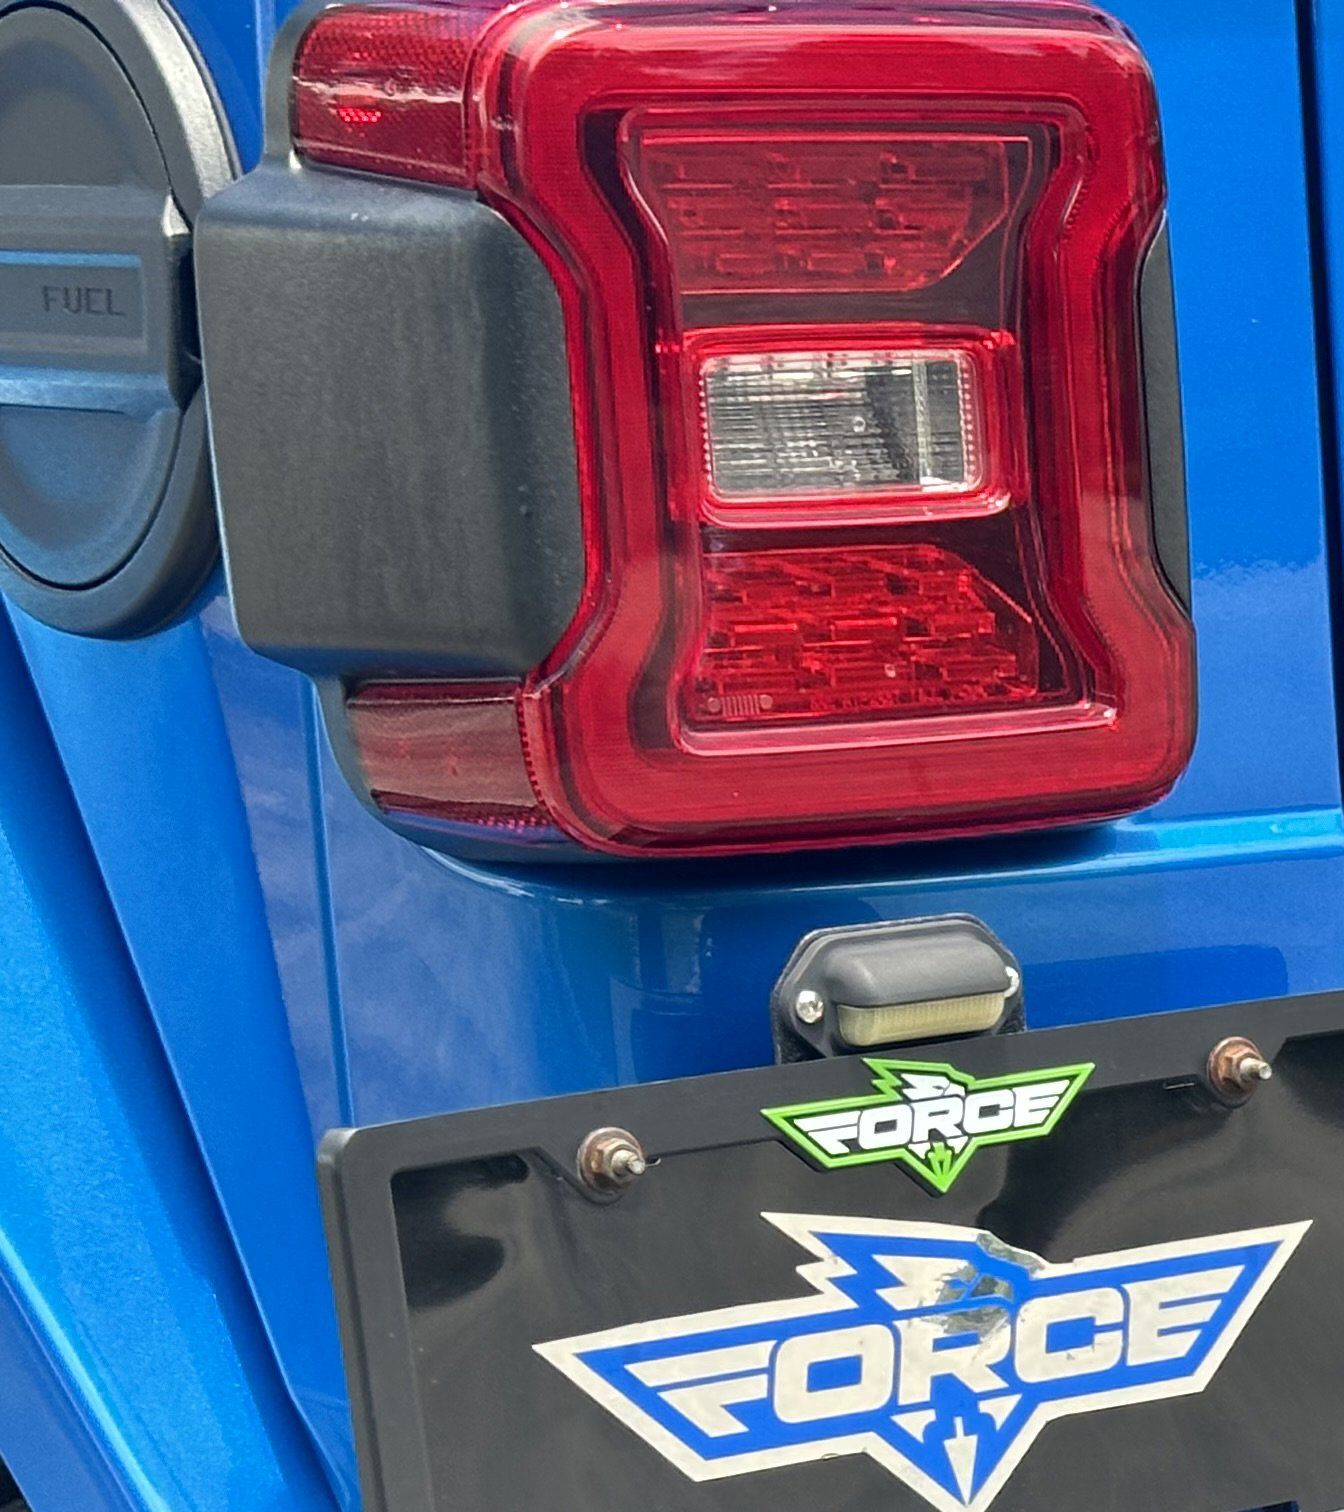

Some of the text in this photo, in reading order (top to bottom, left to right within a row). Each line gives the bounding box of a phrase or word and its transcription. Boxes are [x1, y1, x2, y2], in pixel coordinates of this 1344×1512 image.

[40, 285, 127, 317] FUEL
[793, 1079, 1071, 1156] FORCE
[623, 1264, 1247, 1440] FORCE
